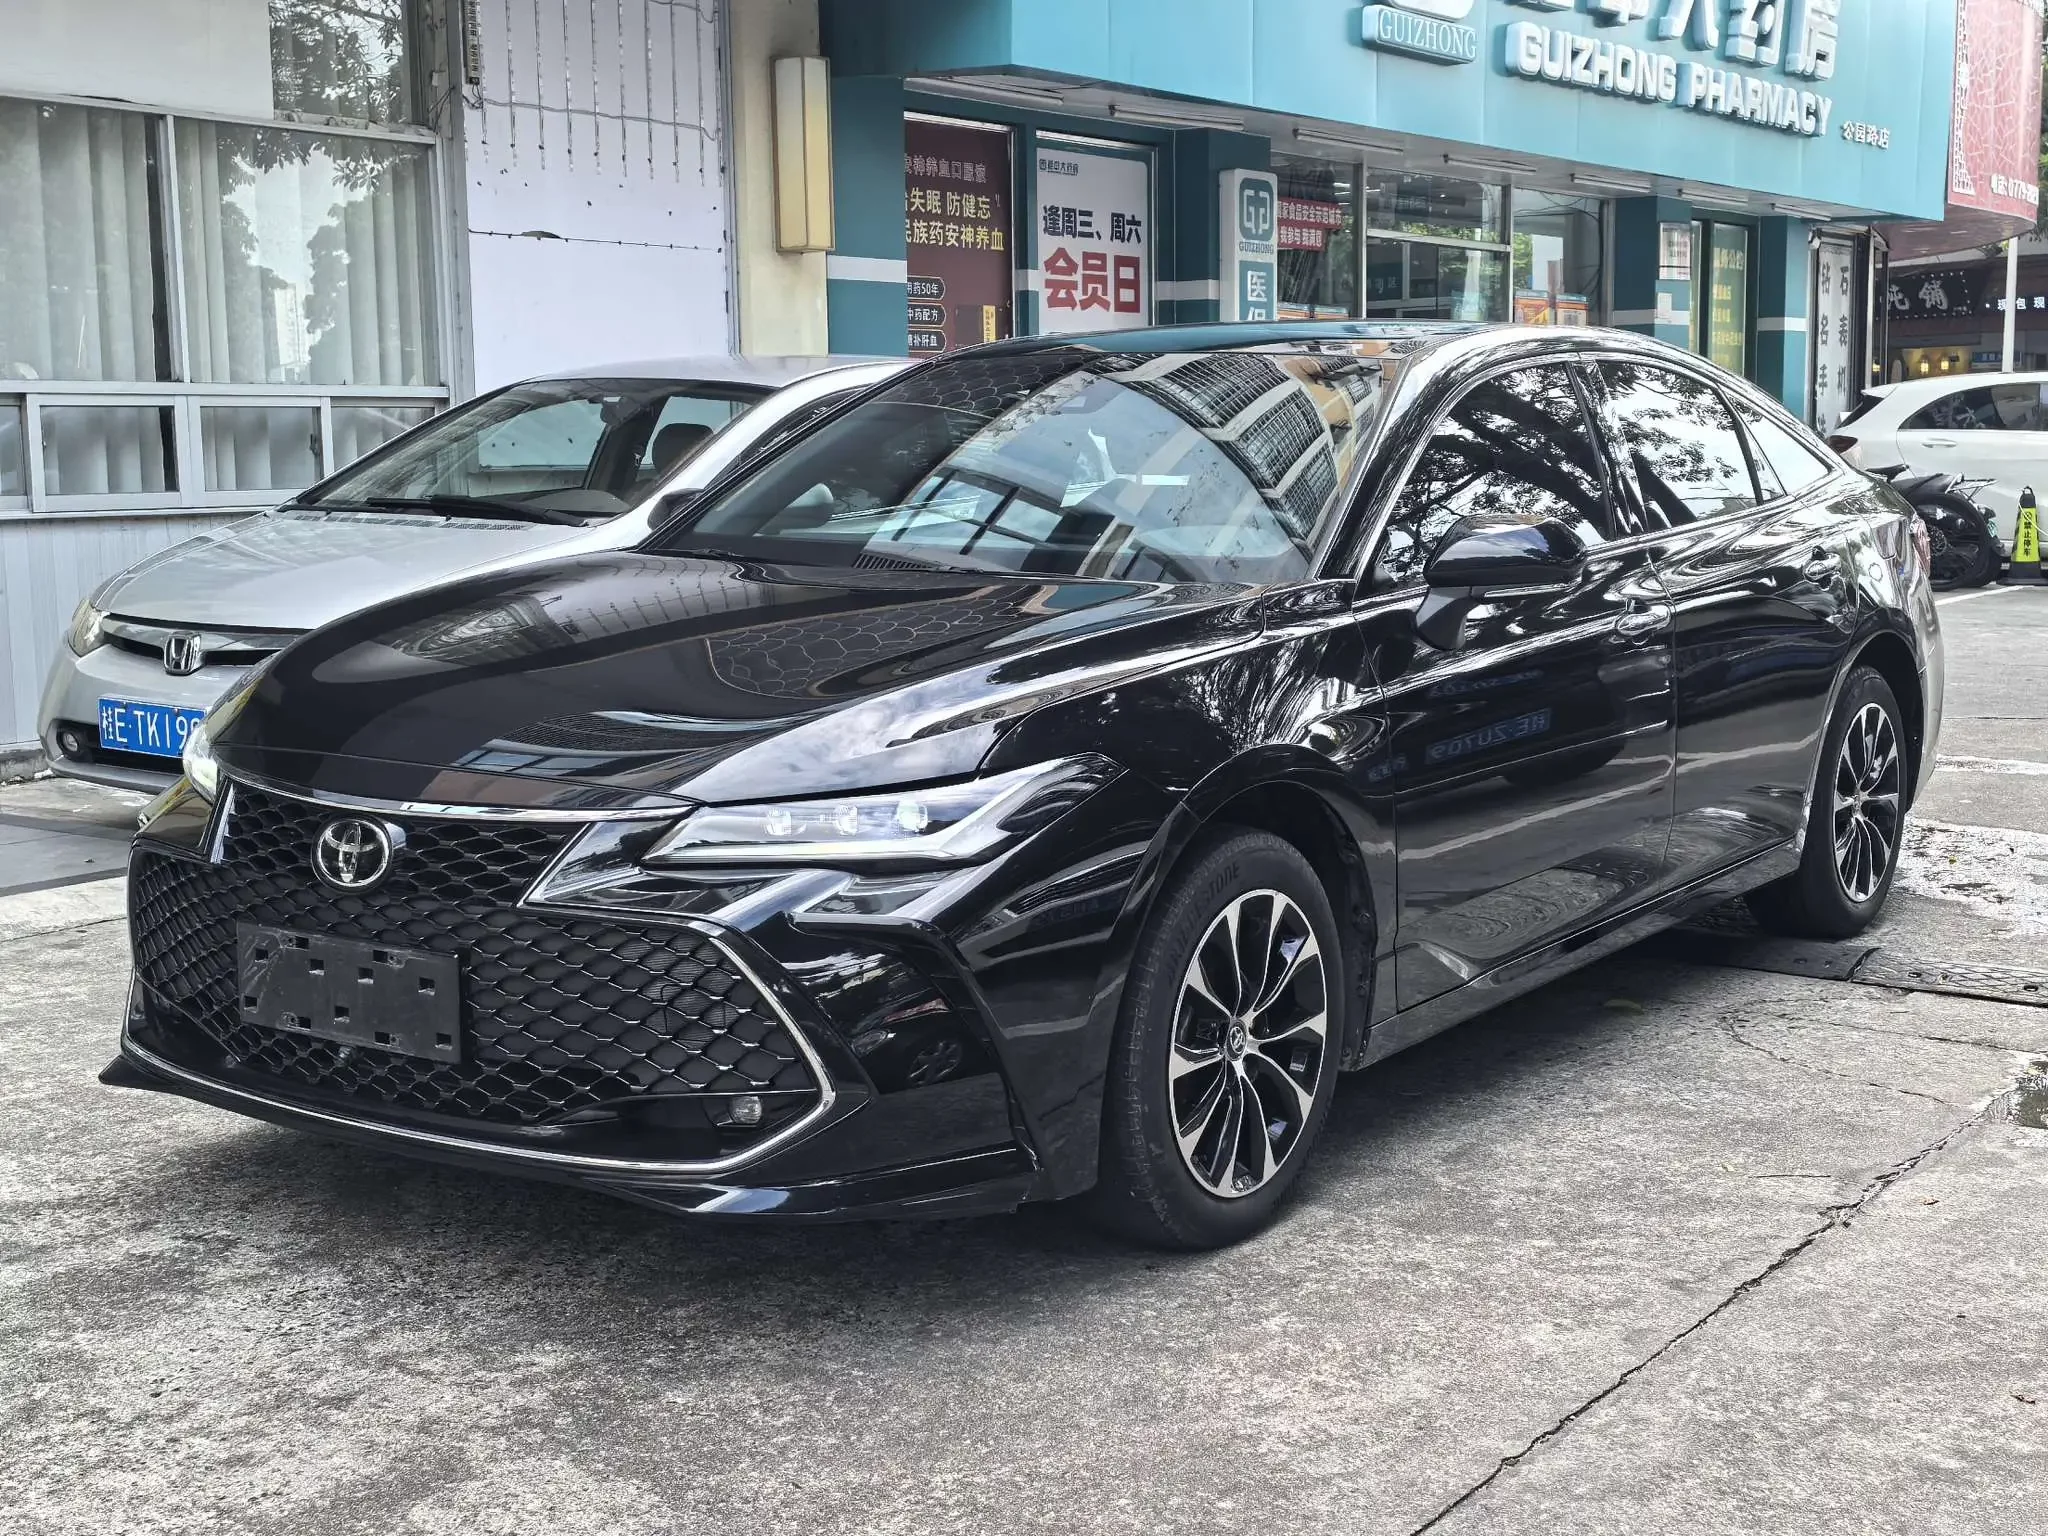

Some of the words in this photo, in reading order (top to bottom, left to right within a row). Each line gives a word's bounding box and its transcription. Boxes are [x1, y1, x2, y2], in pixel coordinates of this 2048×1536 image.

[1379, 9, 1477, 59] GUIZHONG
[1506, 21, 1677, 102] GUIZHONG
[1680, 61, 1833, 137] PHARMACY
[1842, 119, 1890, 150] 公园路店
[905, 186, 942, 215] 失眠
[1043, 205, 1142, 244] 逢周三、周六
[1043, 247, 1141, 313] 会员日
[908, 307, 938, 322] 中药配方
